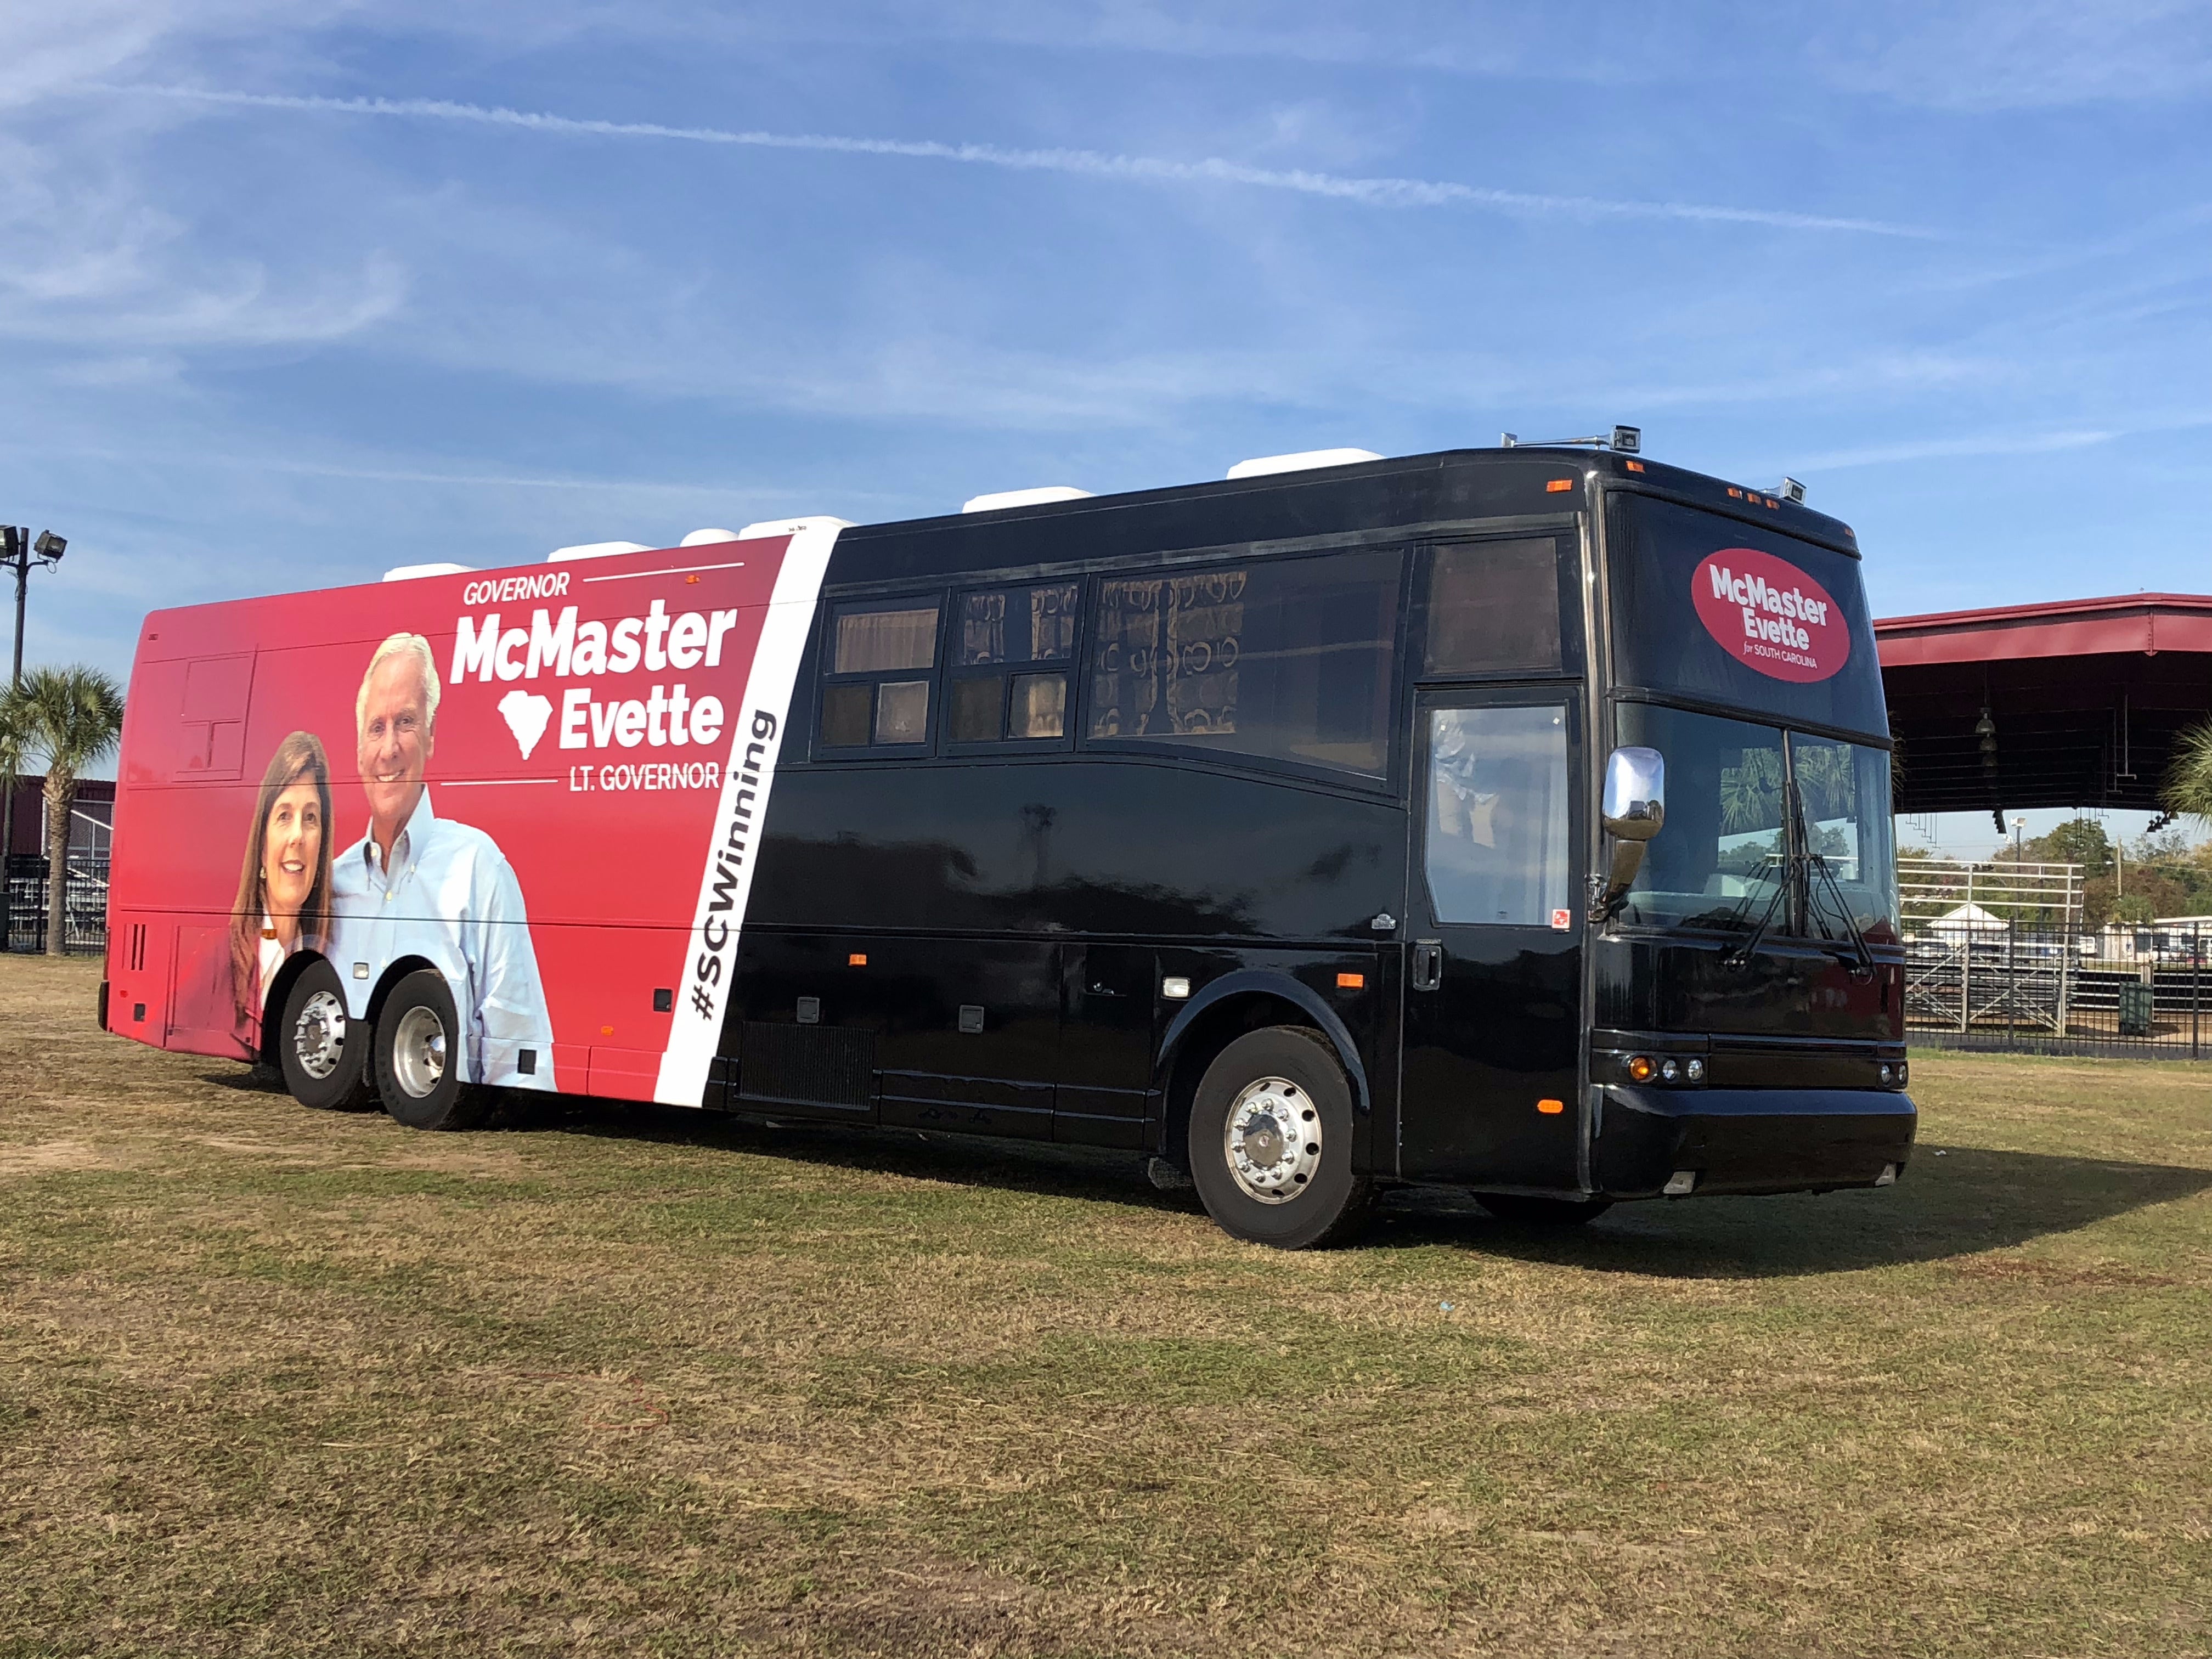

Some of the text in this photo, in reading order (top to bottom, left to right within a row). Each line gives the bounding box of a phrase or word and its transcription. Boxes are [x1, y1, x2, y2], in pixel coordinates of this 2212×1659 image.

[464, 572, 570, 605] GOVERNOR
[1709, 563, 1827, 627] McMaster
[449, 599, 738, 684] McMaster
[1742, 607, 1809, 650] Evette
[1743, 641, 1818, 669] for SOUTH CAROLINA
[559, 684, 724, 749] Evette
[569, 761, 719, 792] LT. GOVERNOR
[691, 709, 777, 1021] #SCWinning
